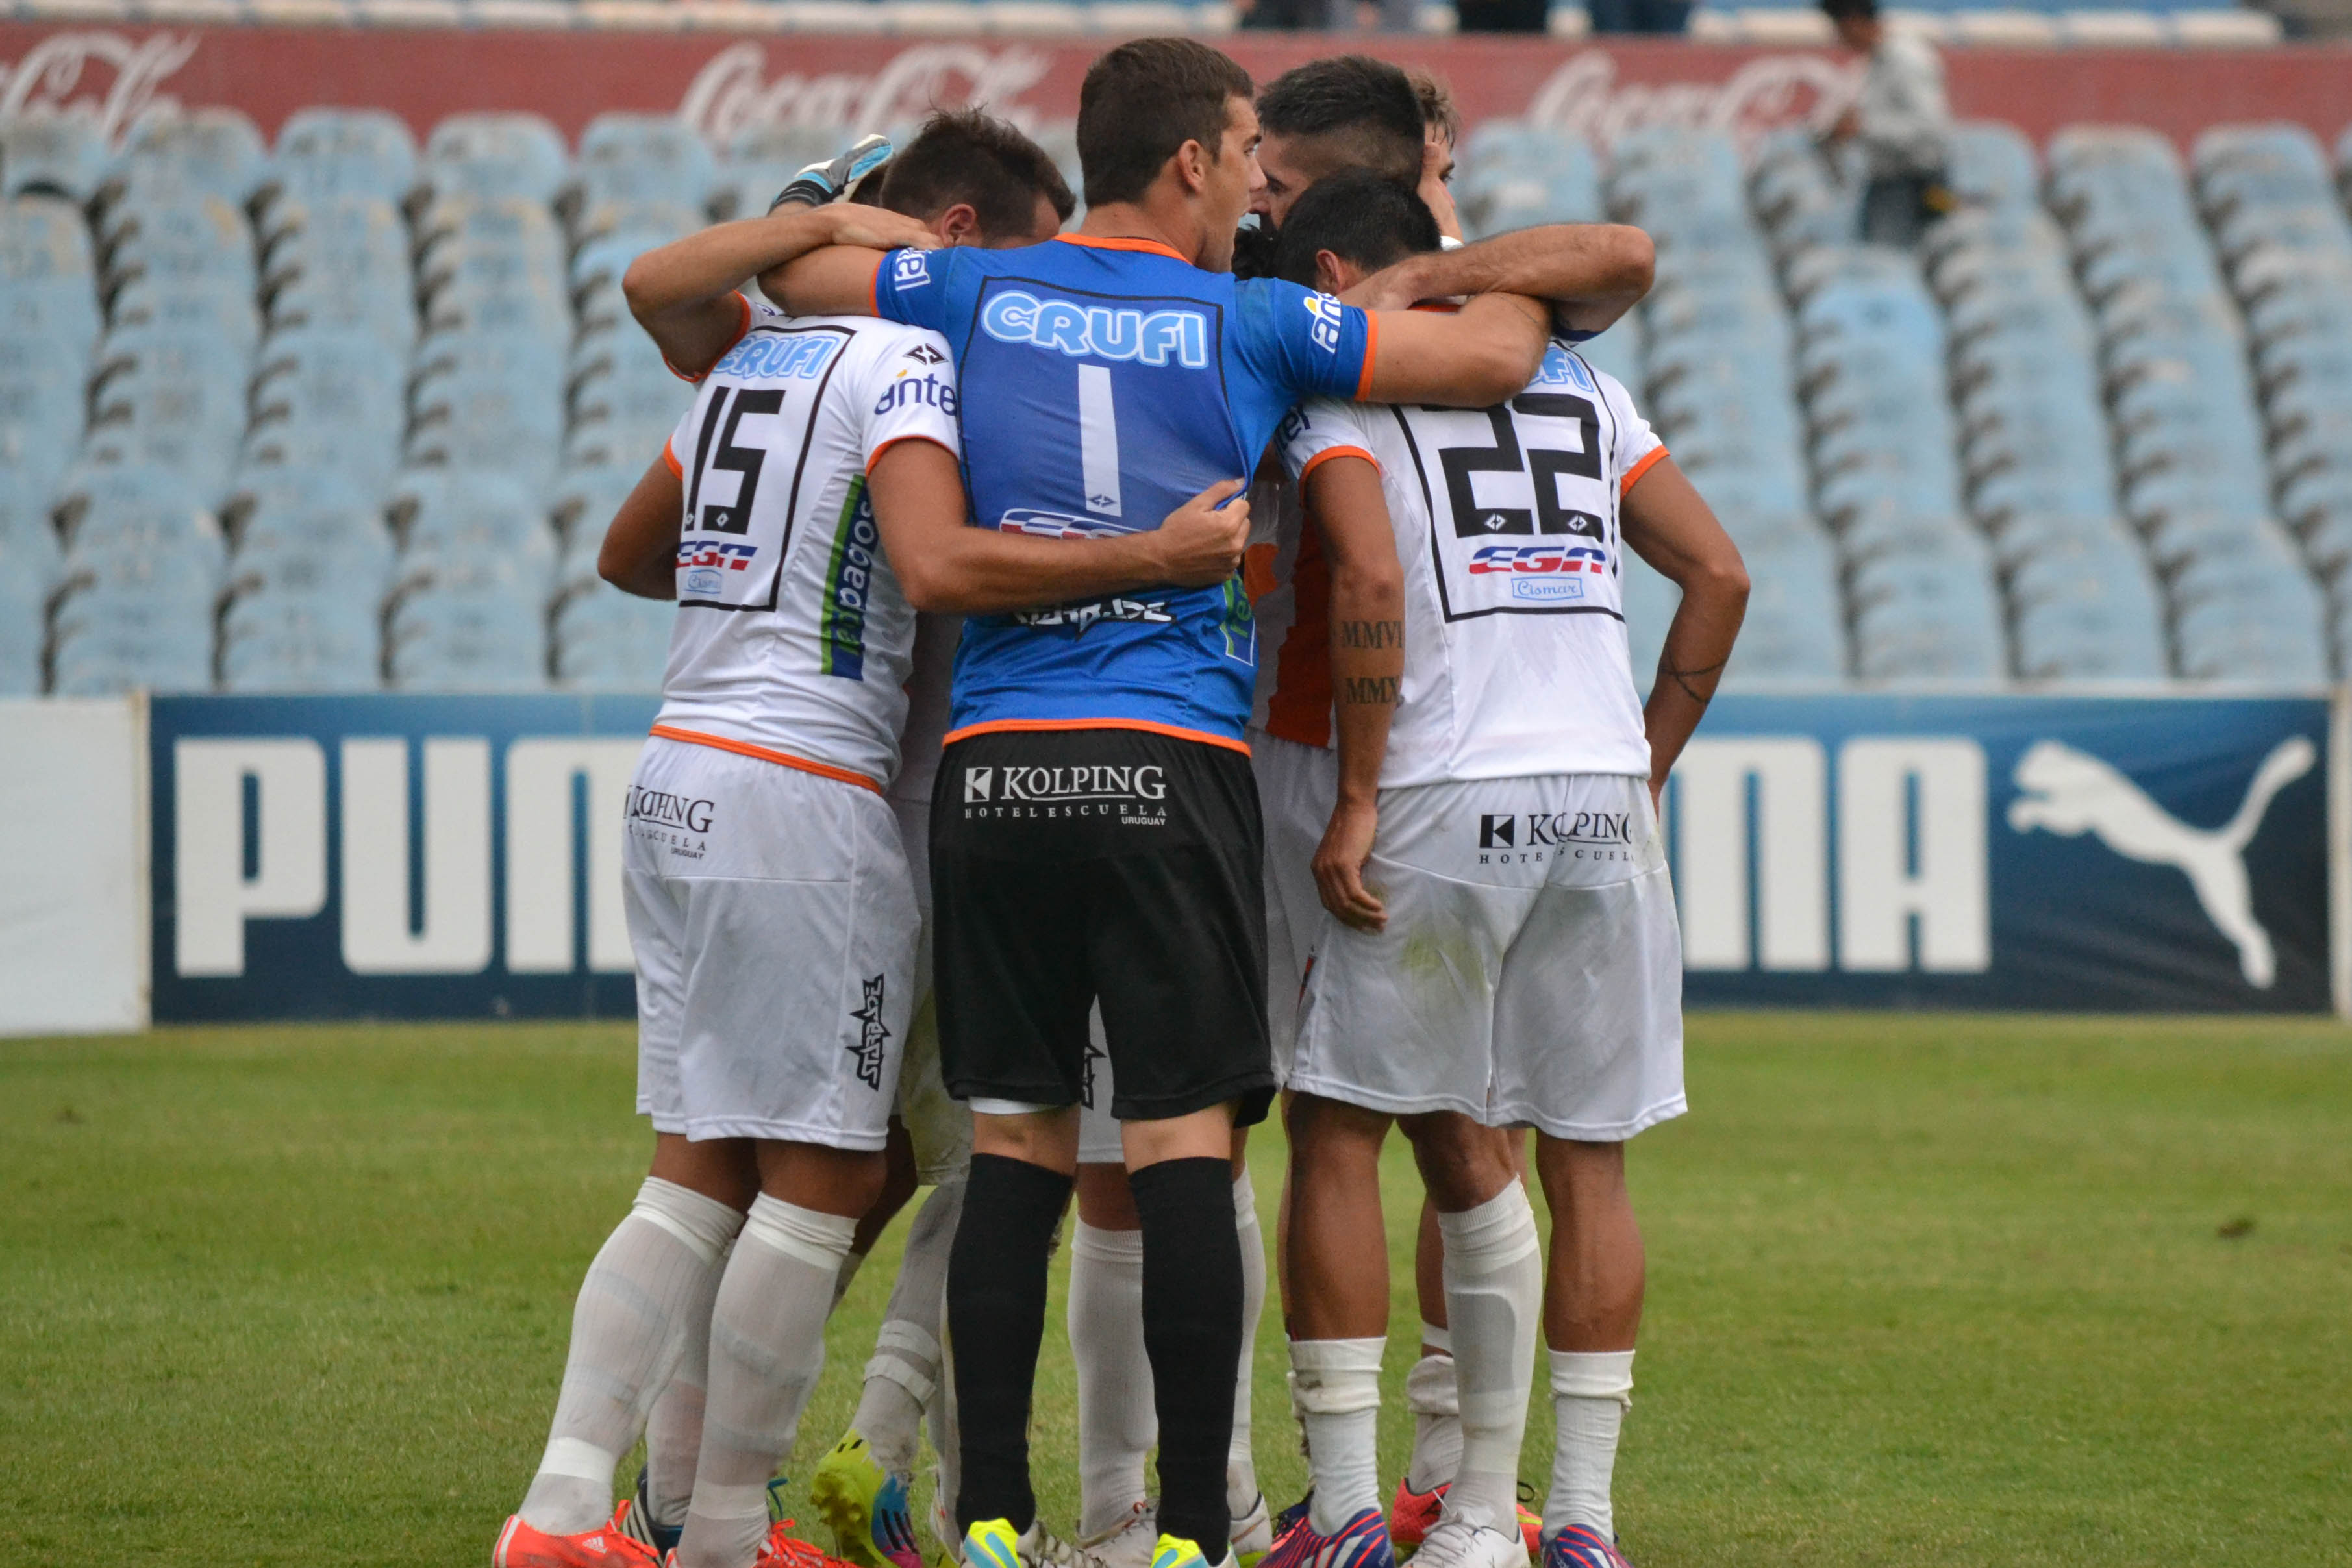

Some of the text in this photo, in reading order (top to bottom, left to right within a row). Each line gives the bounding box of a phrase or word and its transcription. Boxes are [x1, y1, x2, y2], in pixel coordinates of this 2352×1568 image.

[981, 290, 1210, 370] CRUFI
[874, 368, 957, 416] ante
[684, 386, 786, 536] 15
[1078, 363, 1122, 517] 1
[1419, 392, 1605, 538] 22
[1000, 765, 1166, 800] KOLPING
[1121, 816, 1166, 826] URUGUAY
